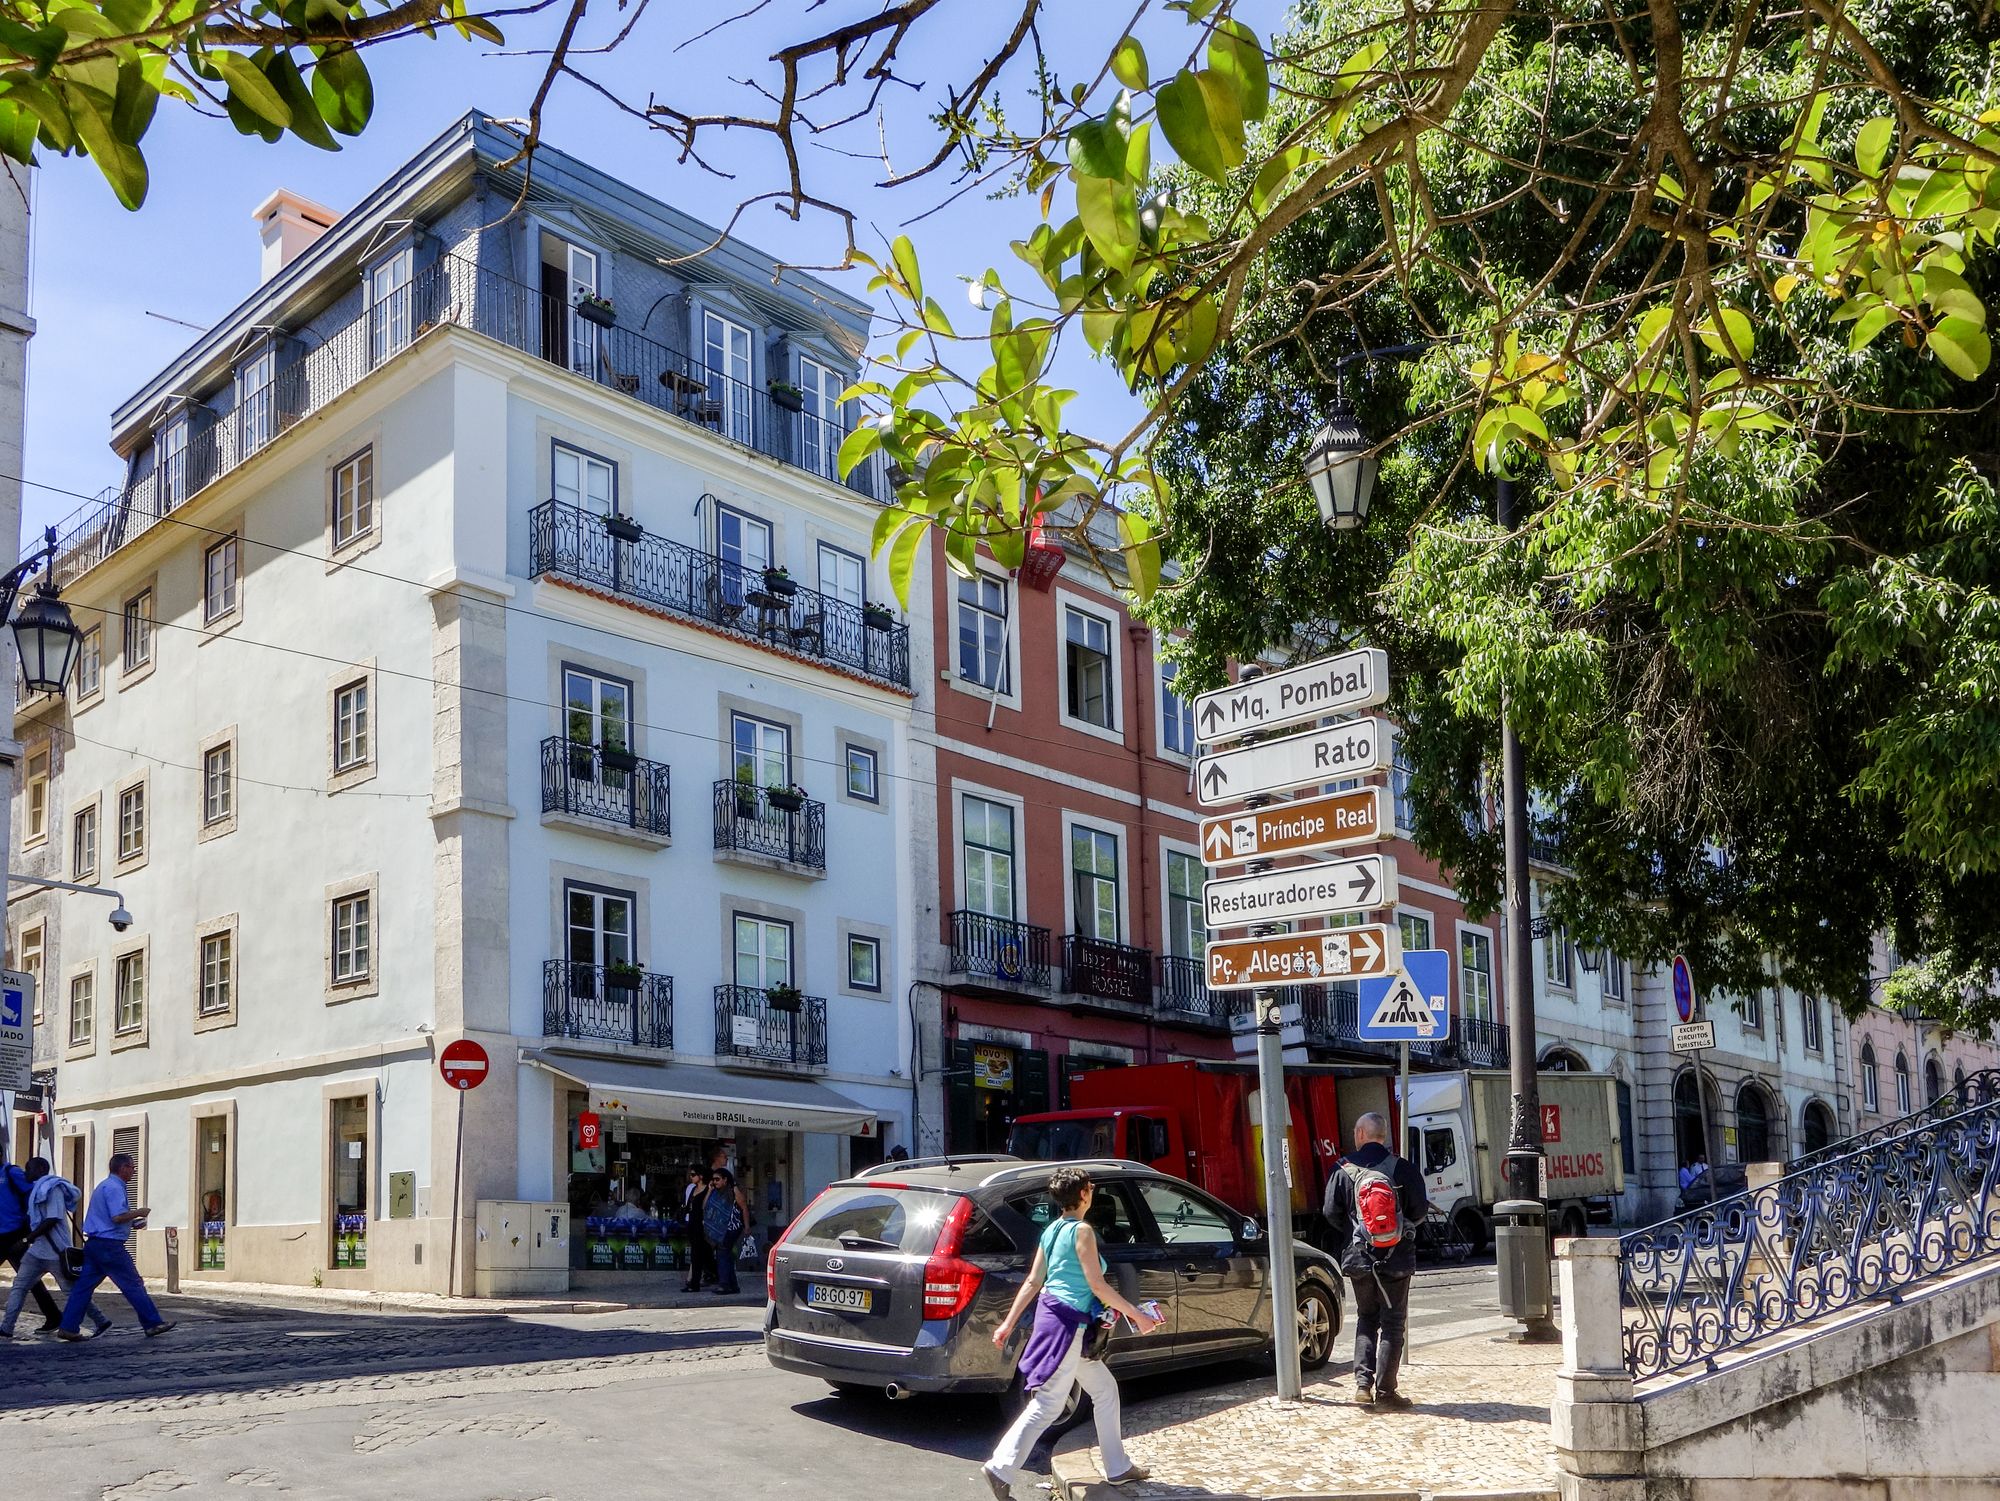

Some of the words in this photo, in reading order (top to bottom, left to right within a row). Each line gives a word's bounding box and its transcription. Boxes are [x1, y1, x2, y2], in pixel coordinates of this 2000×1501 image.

[1231, 695, 1270, 723] Mq.
[1280, 663, 1367, 709] Pombal
[1314, 736, 1371, 768] Rato
[1262, 815, 1325, 843] Príncipe
[1335, 802, 1374, 829] Real
[1210, 883, 1337, 914] Restauradores
[1212, 954, 1237, 983] Pç.
[3, 976, 21, 987] CAL
[1679, 1025, 1705, 1034] EXCEPTO
[0, 1030, 24, 1041] IADO
[1677, 1032, 1709, 1042] CIRCUITOS
[683, 1111, 715, 1121] Pastelaria
[716, 1111, 747, 1123] BRASIL
[747, 1116, 784, 1127] Restaurante
[593, 1244, 613, 1253] FINAL
[624, 1245, 644, 1254] FINAL
[655, 1245, 674, 1254] FINAL
[828, 1260, 842, 1269] KIA
